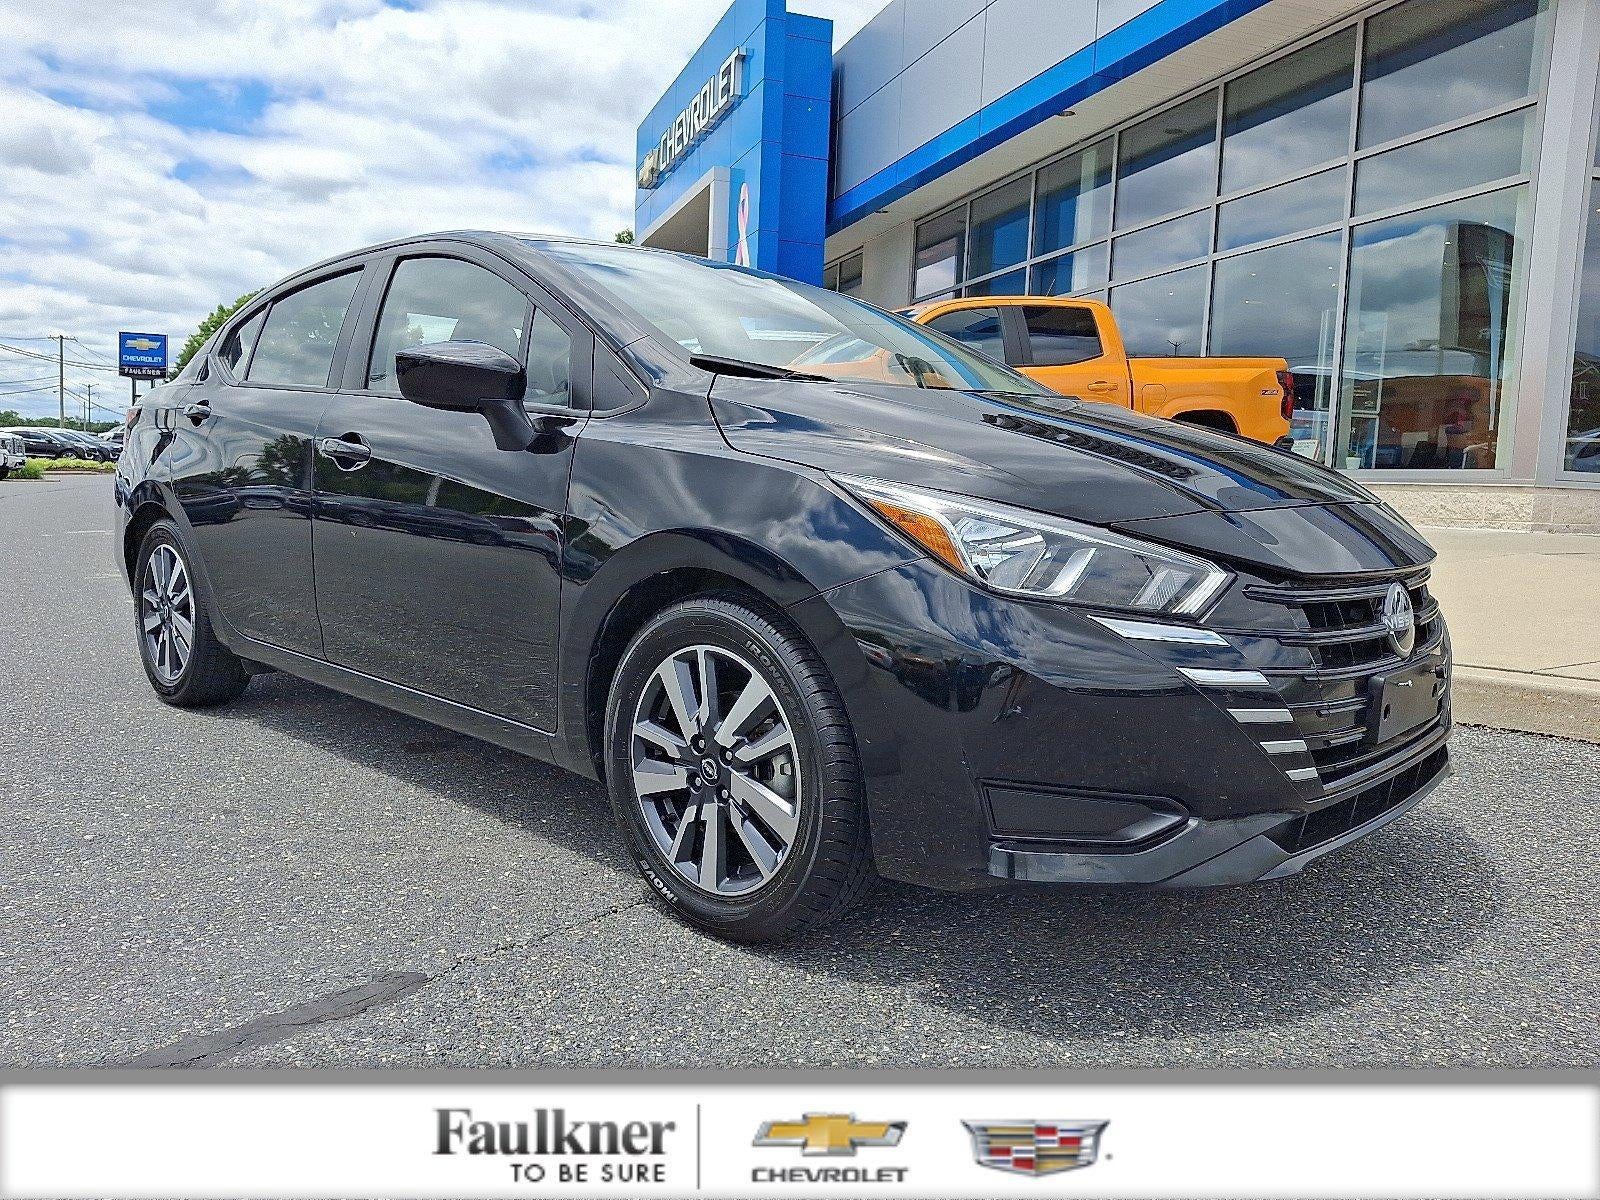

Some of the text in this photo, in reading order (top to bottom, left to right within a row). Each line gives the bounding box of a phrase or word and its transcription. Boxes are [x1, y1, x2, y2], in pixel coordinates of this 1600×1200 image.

[660, 46, 746, 171] CHEVROLET
[122, 355, 163, 363] CHEVROLET
[124, 367, 161, 375] FAULKNER
